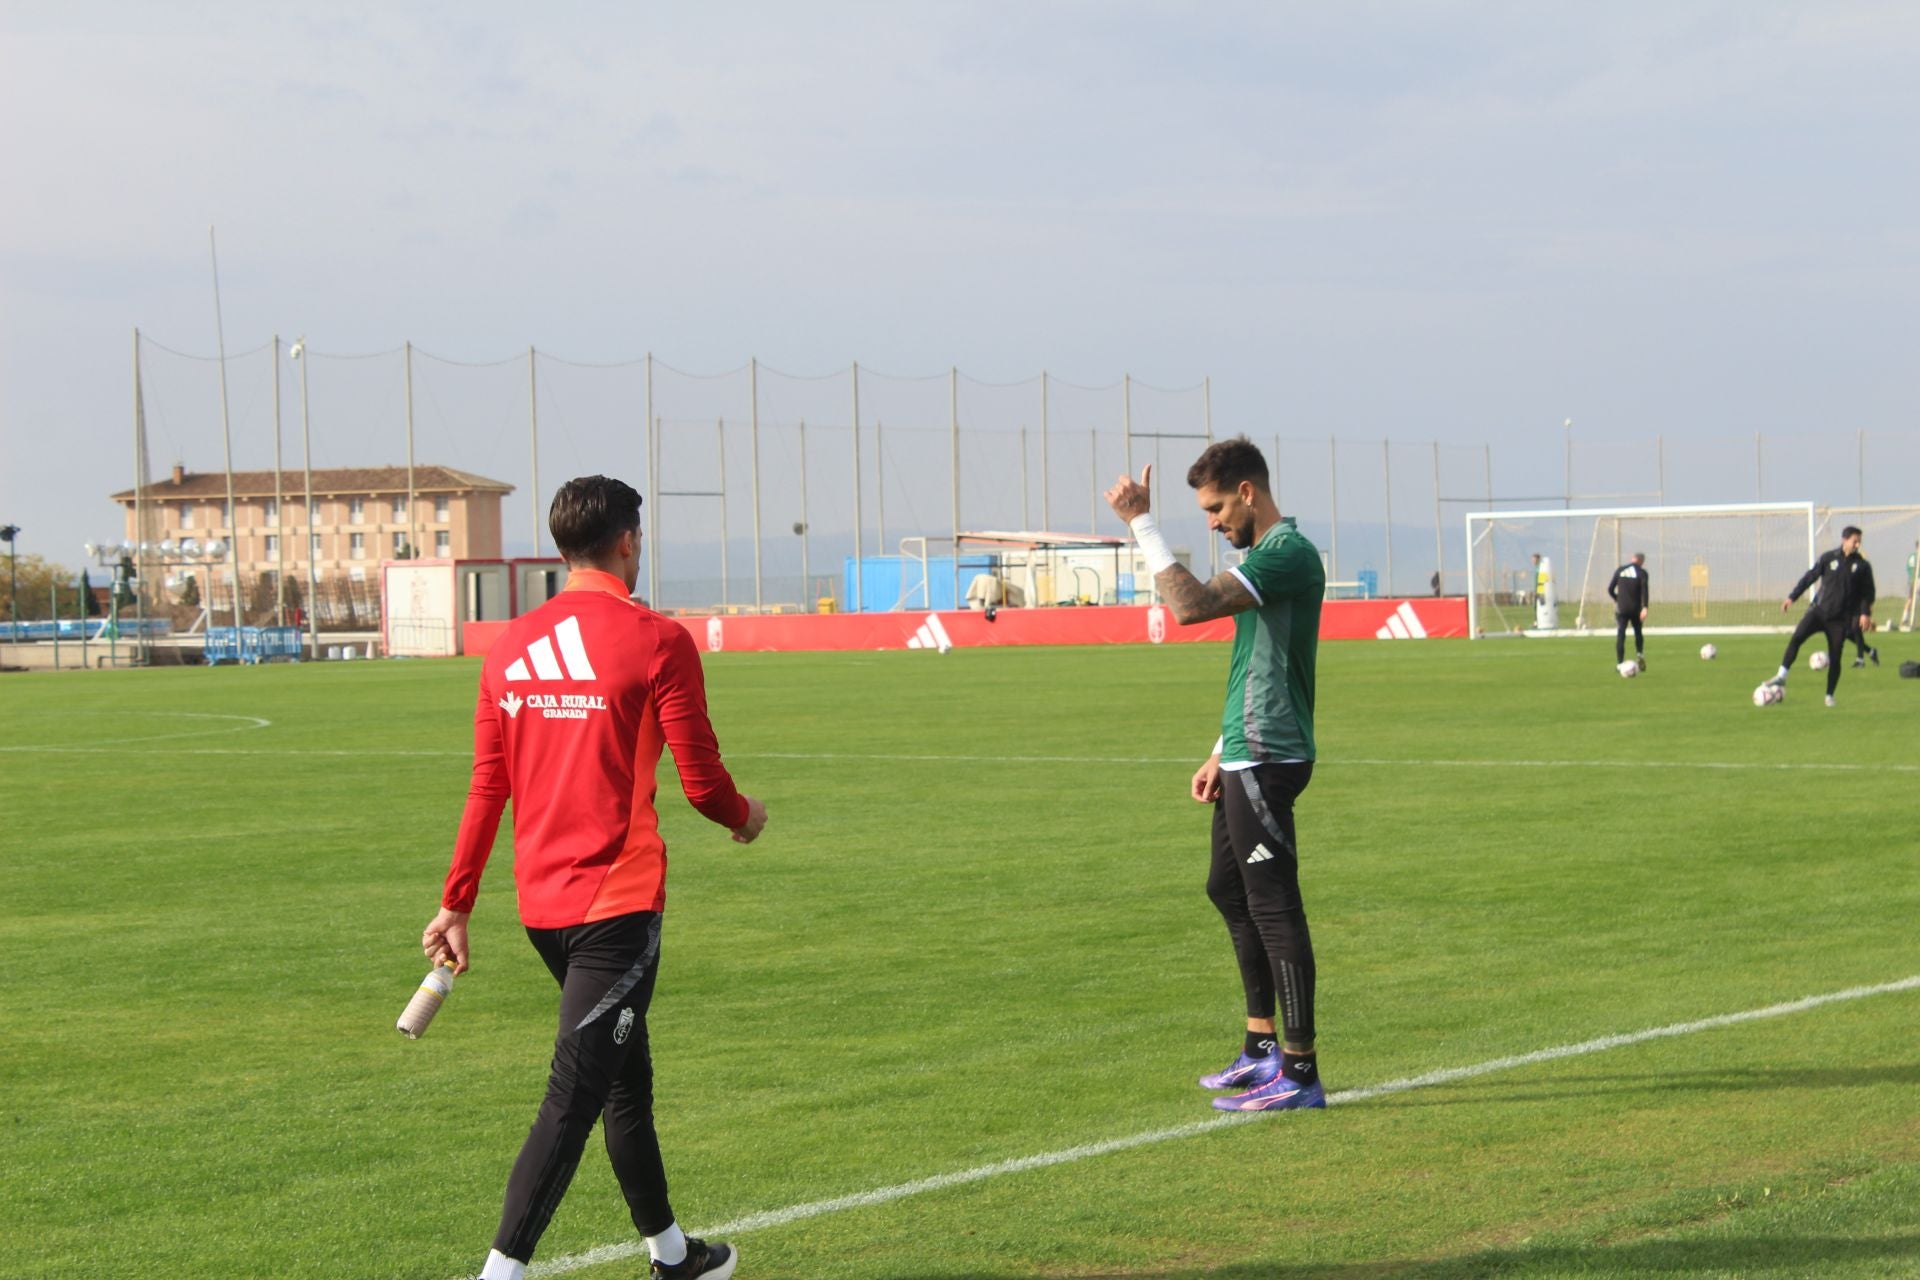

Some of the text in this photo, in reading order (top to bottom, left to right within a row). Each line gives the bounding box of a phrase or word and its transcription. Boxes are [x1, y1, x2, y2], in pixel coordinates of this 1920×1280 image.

[526, 694, 607, 710] CAJA RURAL
[542, 708, 588, 719] GRANADA
